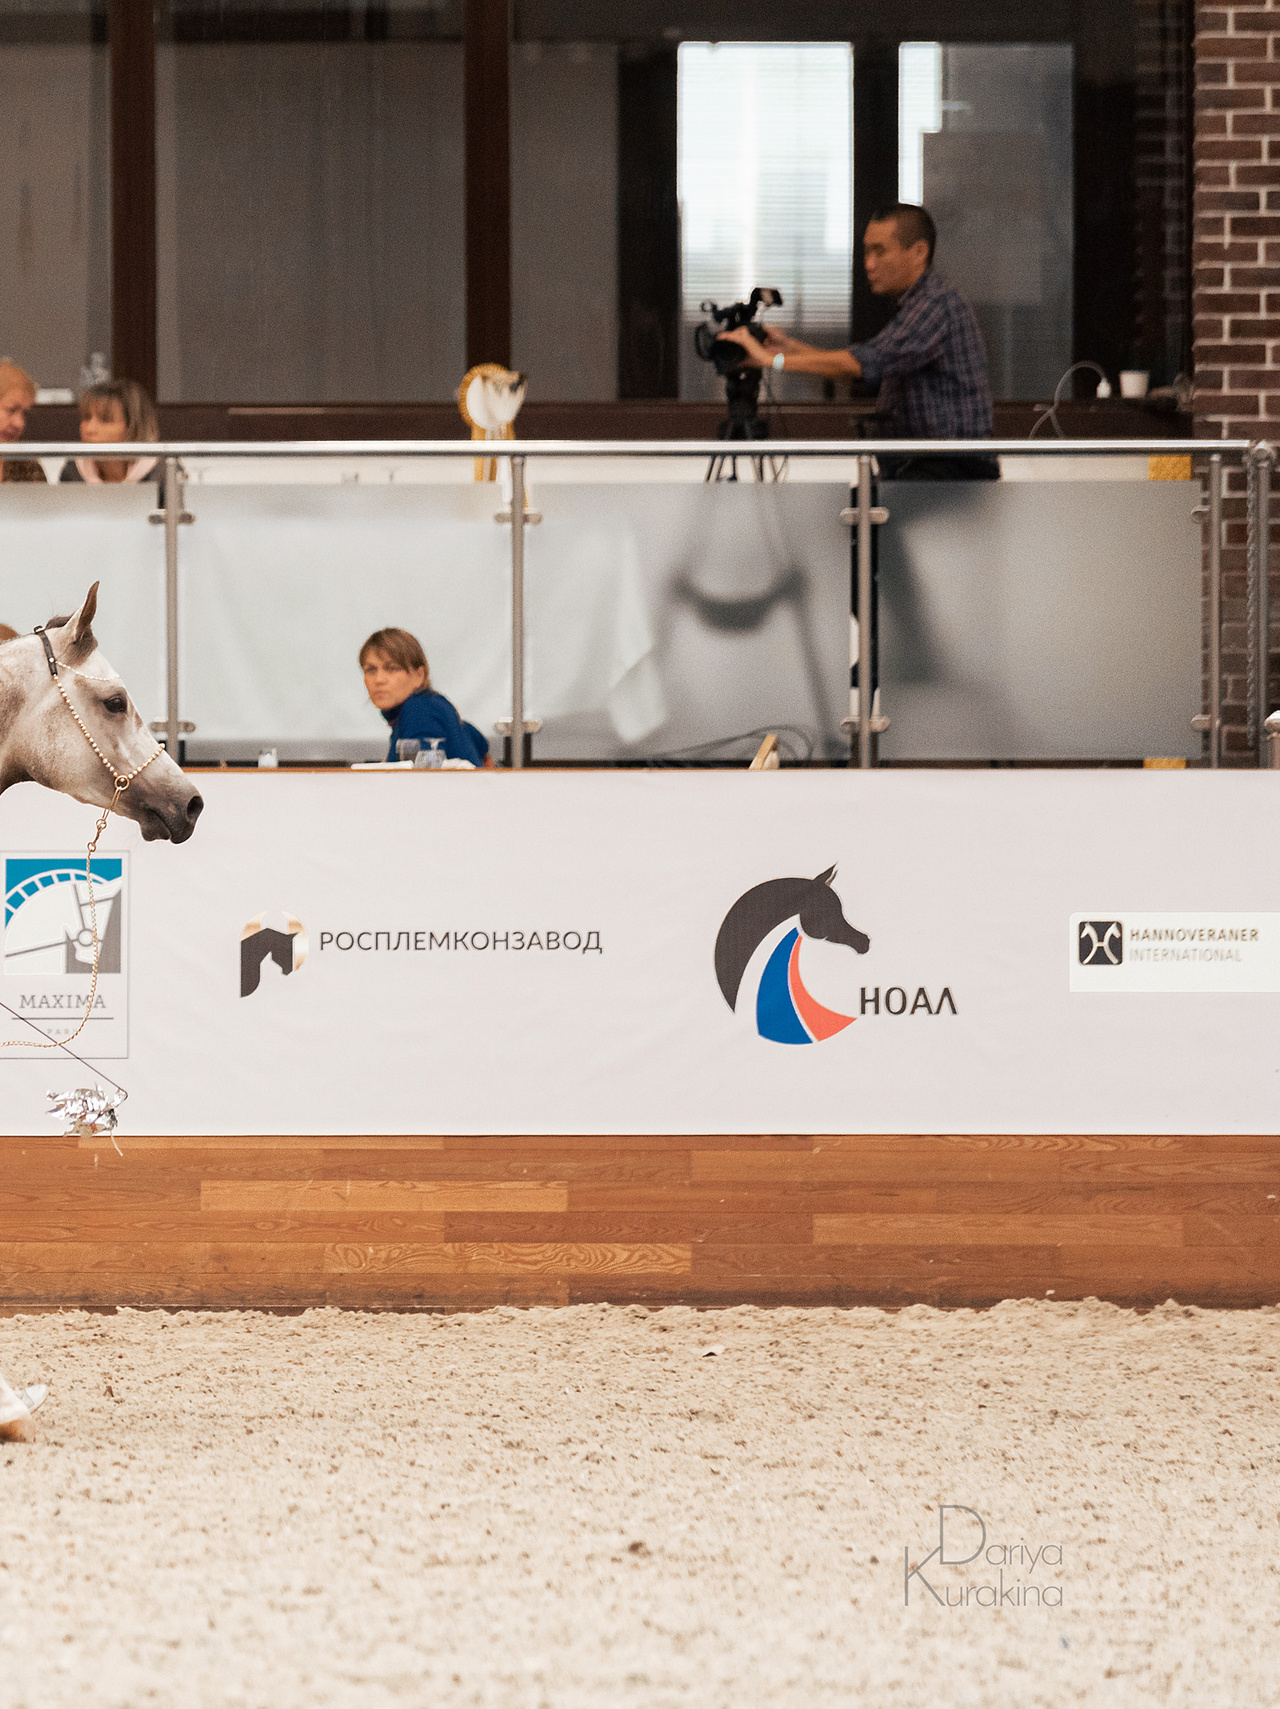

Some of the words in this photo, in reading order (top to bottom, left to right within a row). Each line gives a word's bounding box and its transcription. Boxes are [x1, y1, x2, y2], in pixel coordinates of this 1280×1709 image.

[319, 930, 603, 955] РОСПЛЕМКОНЗАВОД
[1129, 927, 1260, 943] HANNOVERANER
[1128, 947, 1243, 963] INTERNATIONAL
[18, 994, 107, 1009] MAXIMA
